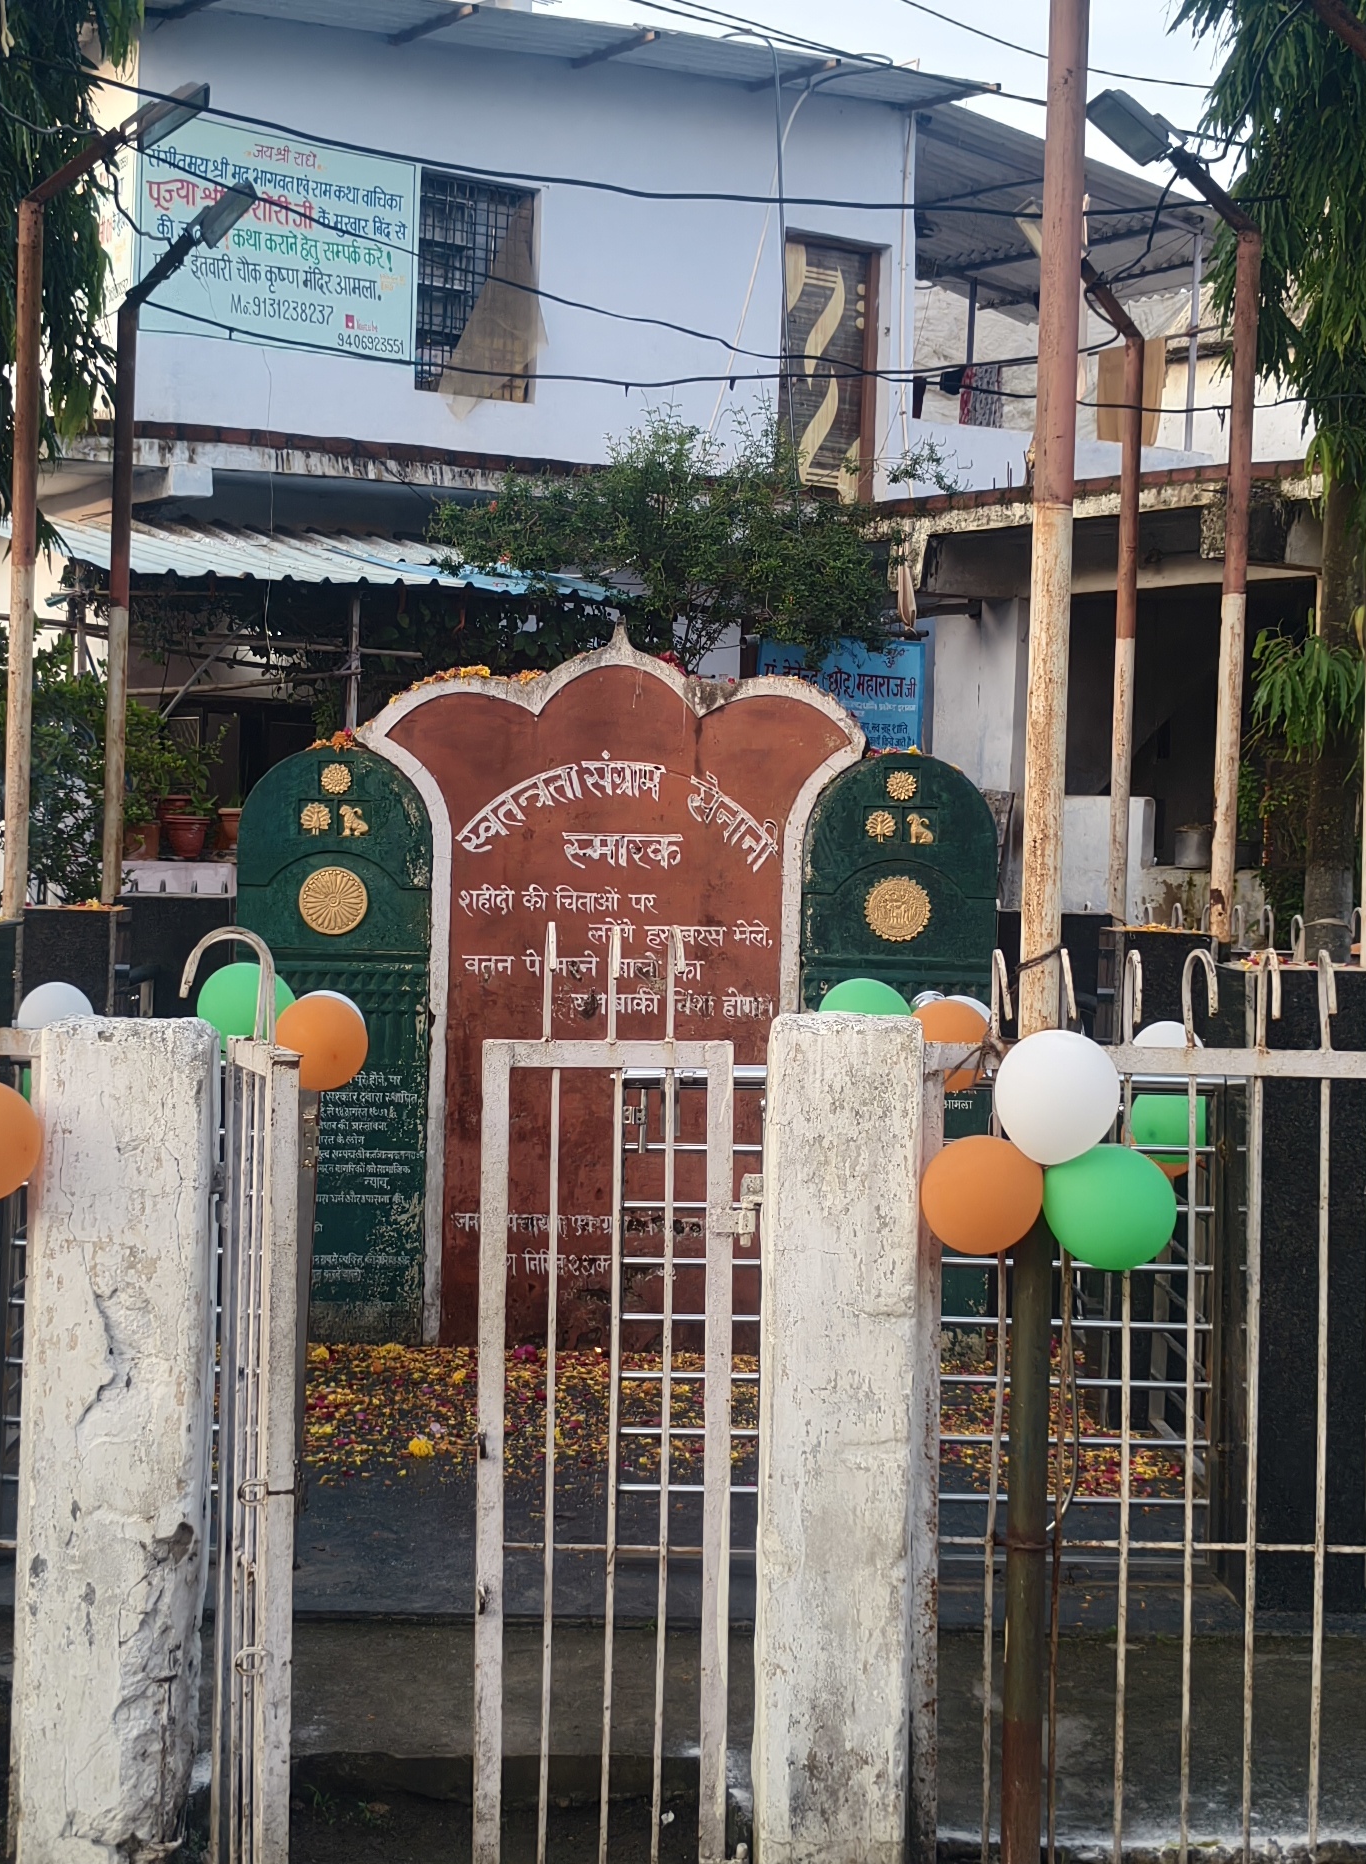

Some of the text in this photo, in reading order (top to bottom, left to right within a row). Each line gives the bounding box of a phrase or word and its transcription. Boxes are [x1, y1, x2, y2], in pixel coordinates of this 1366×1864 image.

[252, 143, 275, 161] जय
[275, 144, 292, 164] श्री
[148, 144, 211, 178] संगीतमय
[210, 157, 231, 181] श्री
[252, 167, 295, 193] भागवत
[311, 180, 333, 200] राम
[334, 185, 361, 205] कथा
[362, 185, 405, 212] वाचिका
[232, 227, 262, 252] कथा
[299, 231, 321, 266] हेतु
[322, 238, 361, 265] सम्पर्क
[235, 256, 262, 284] चौक
[264, 264, 300, 293] कृष्ण
[302, 266, 334, 296] मंदिर
[337, 332, 405, 355] 9406923551
[856, 672, 906, 700] महाराज
[455, 750, 779, 873] स्वतन्त्रता संग्राम सेनानी
[561, 830, 684, 870] स्मारक
[521, 883, 549, 912] की
[552, 884, 622, 915] चिताओं
[628, 892, 659, 915] पर
[461, 954, 516, 978] वतन
[521, 949, 543, 977] पे
